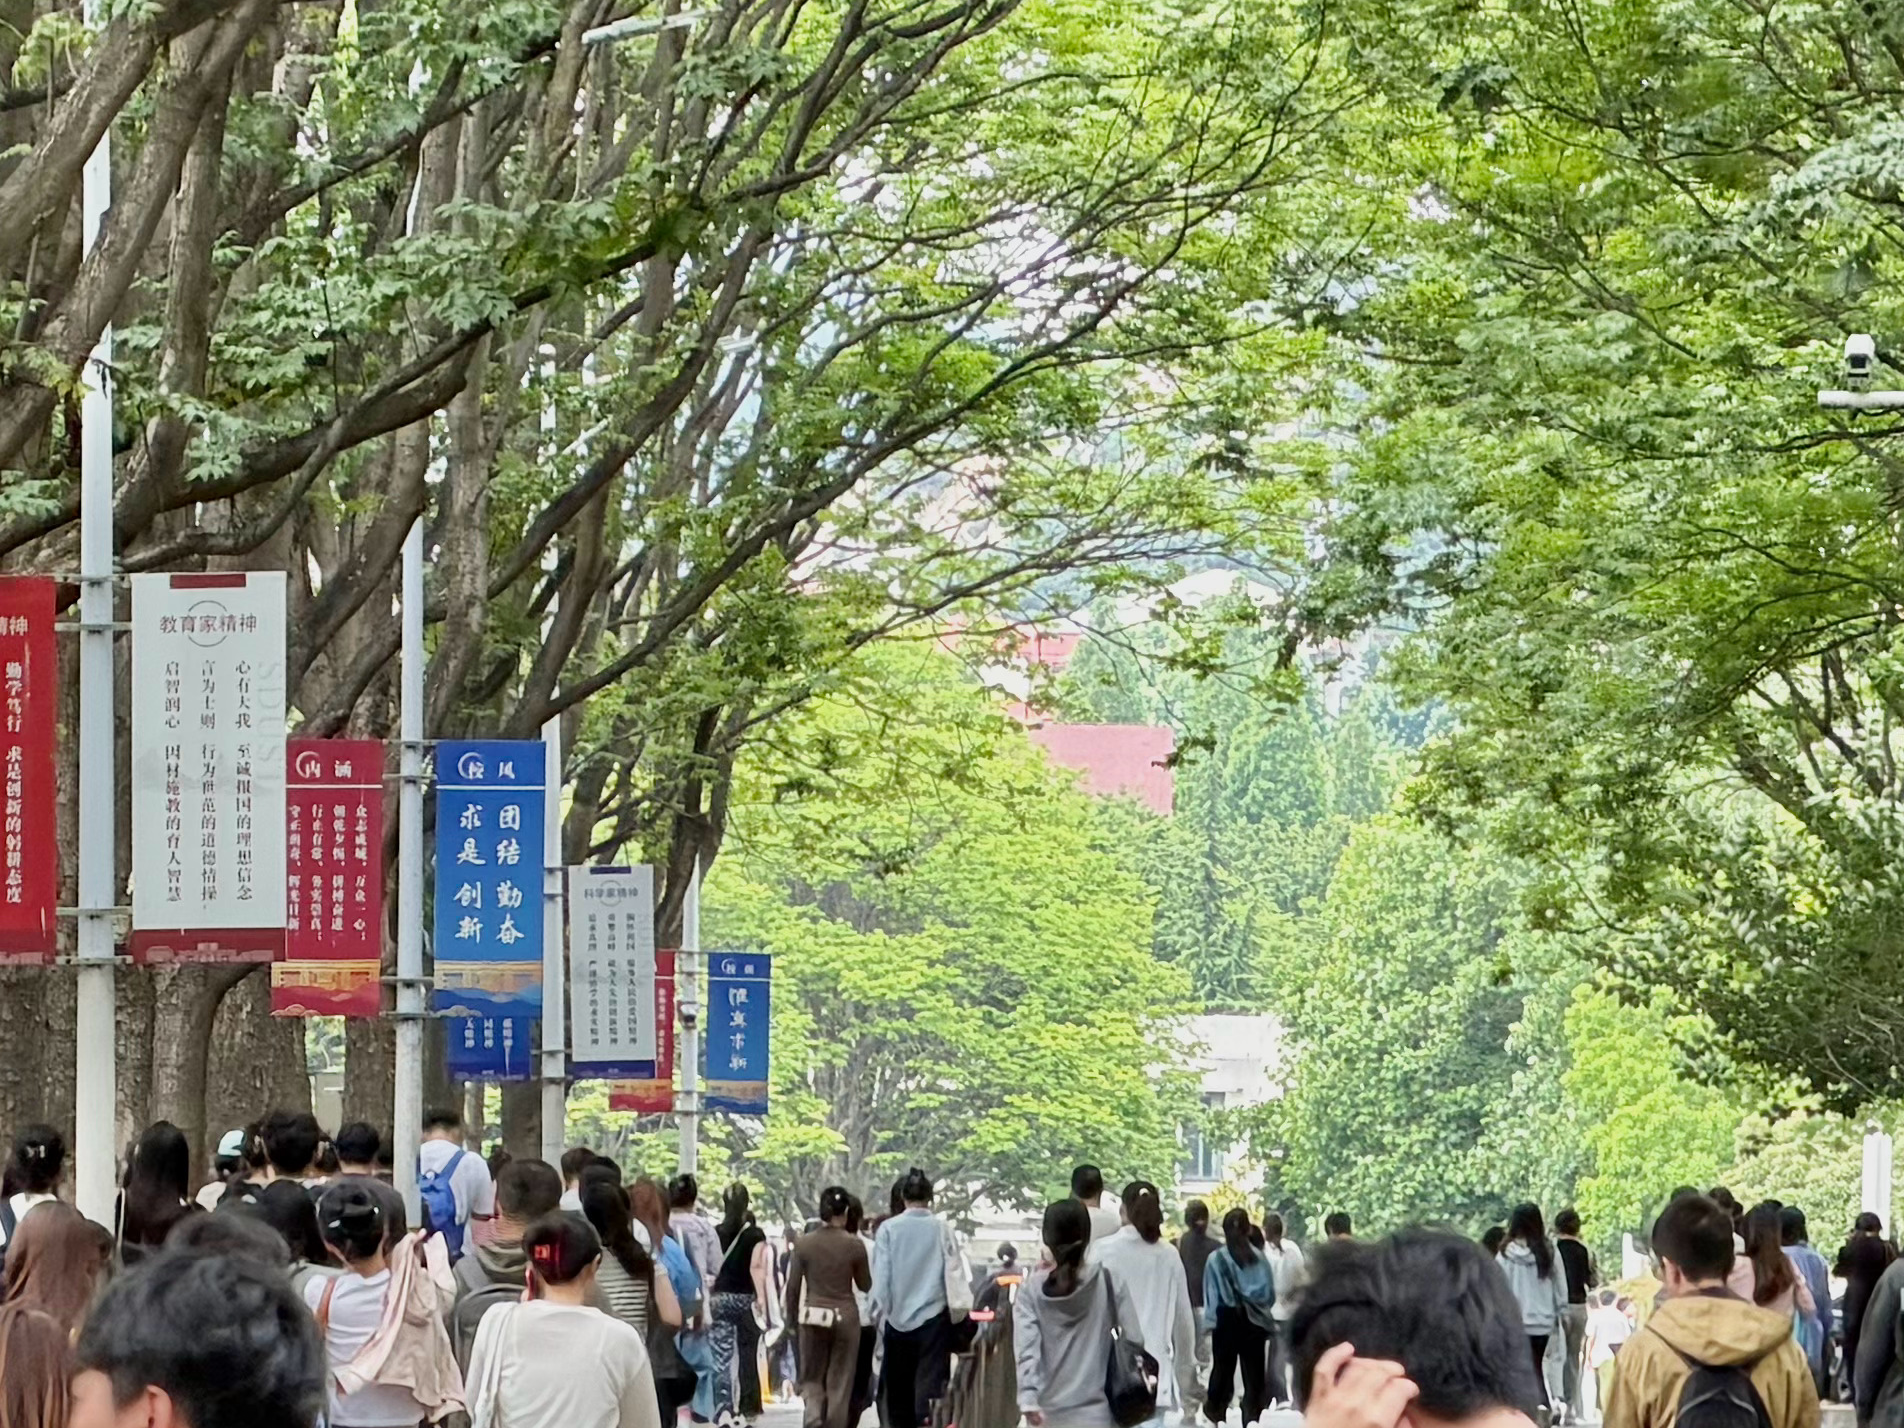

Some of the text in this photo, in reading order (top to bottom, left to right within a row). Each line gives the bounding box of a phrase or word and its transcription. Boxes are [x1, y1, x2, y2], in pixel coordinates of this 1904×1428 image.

[159, 613, 258, 635] 教育家精神
[234, 660, 252, 730] 心有大我
[453, 803, 486, 944] 求是 创新
[496, 804, 525, 944] 团结 勤奋
